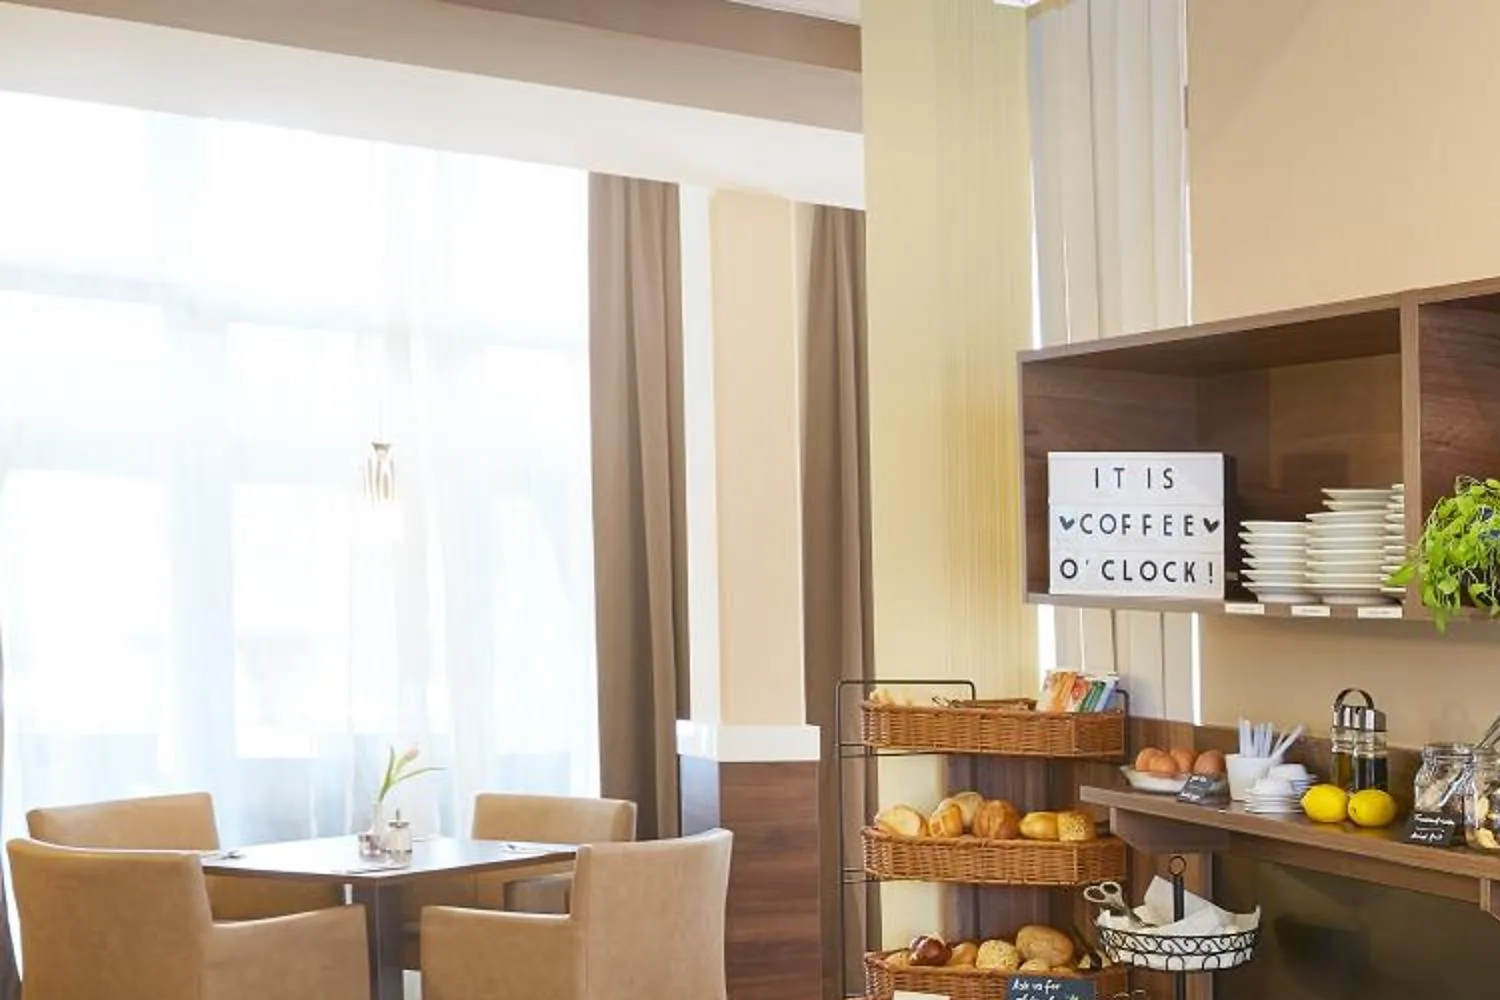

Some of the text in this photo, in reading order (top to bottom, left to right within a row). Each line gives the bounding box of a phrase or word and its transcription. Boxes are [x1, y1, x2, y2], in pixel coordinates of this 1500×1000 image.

[1095, 467, 1174, 489] IT IS
[1079, 513, 1194, 537] COFFEE
